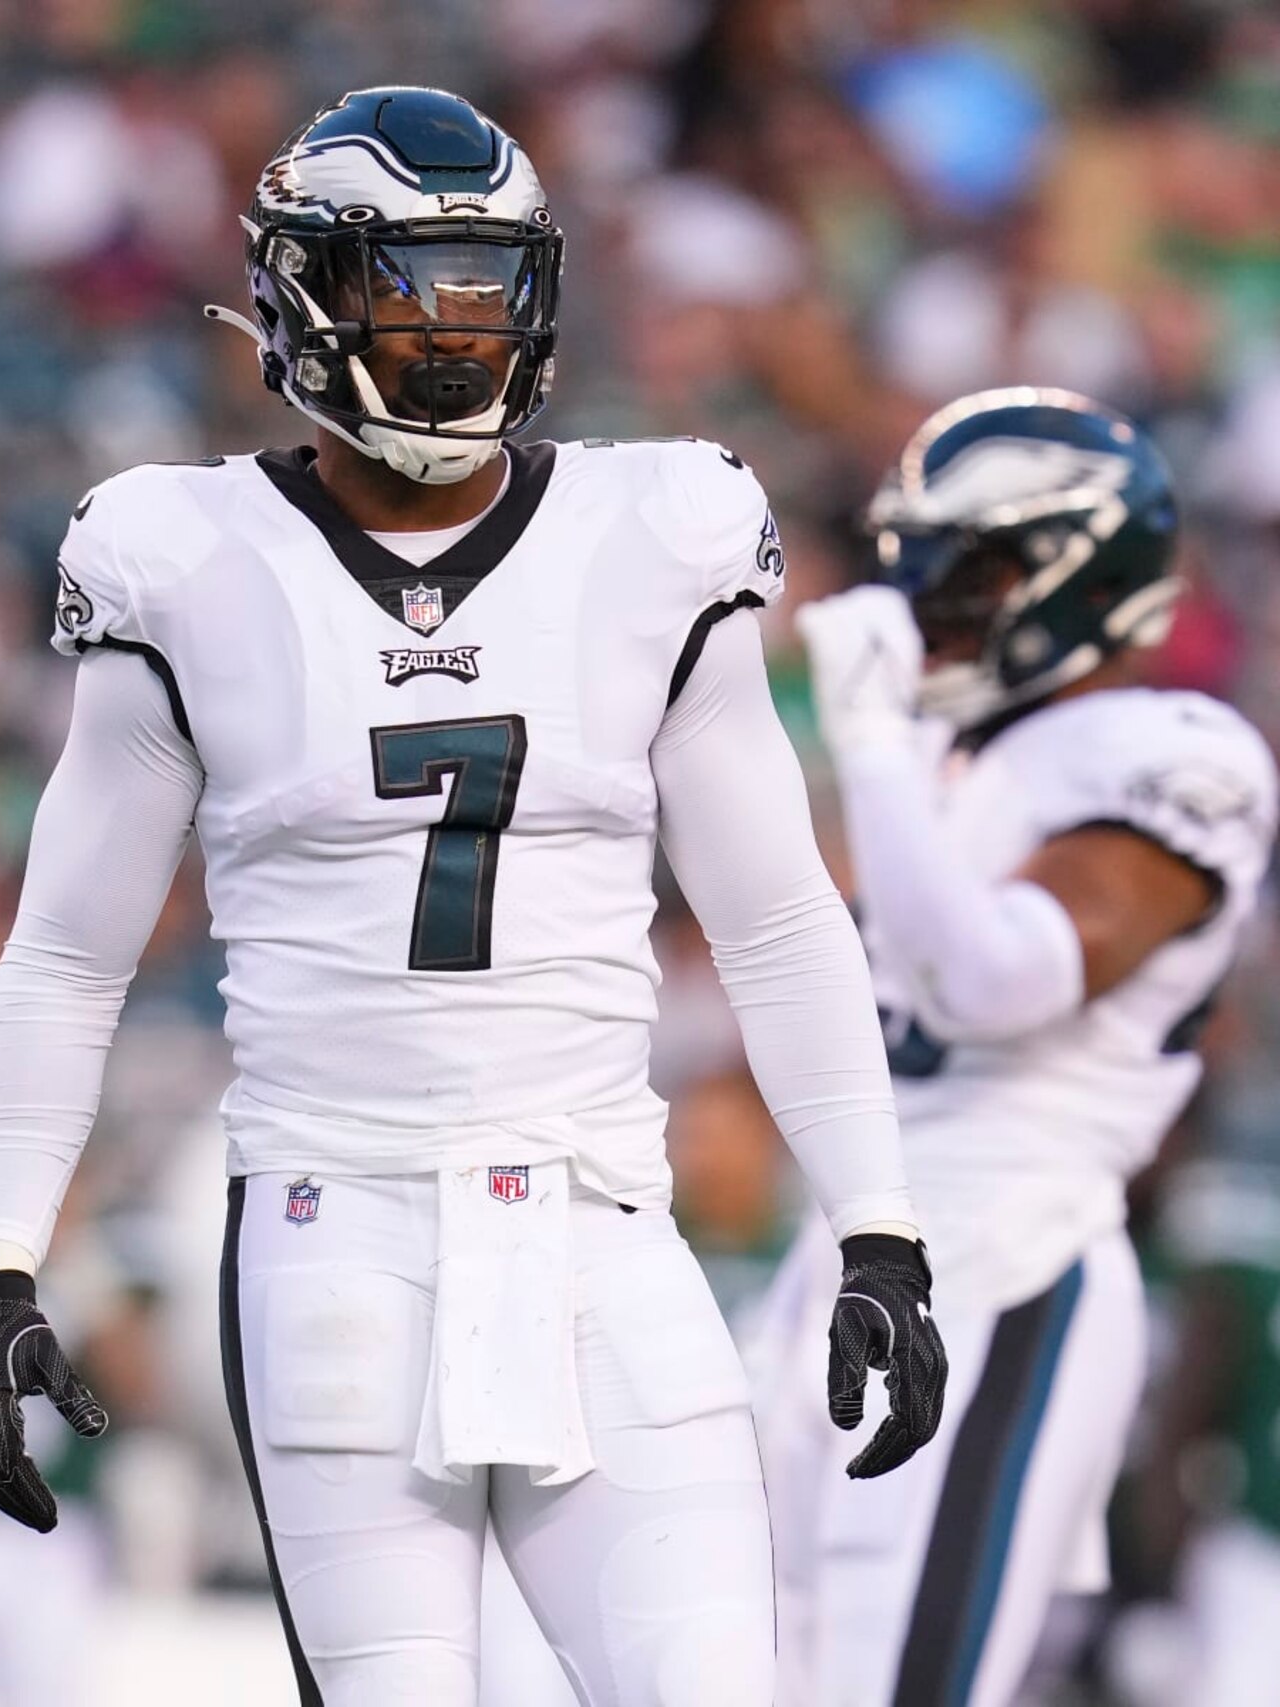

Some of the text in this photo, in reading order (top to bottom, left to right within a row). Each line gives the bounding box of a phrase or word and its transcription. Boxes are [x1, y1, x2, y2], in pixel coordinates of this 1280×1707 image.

[410, 603, 438, 622] NFL
[378, 645, 482, 687] EAGLES
[369, 713, 528, 971] 7
[492, 1175, 526, 1200] NFL
[289, 1200, 314, 1217] NFL
